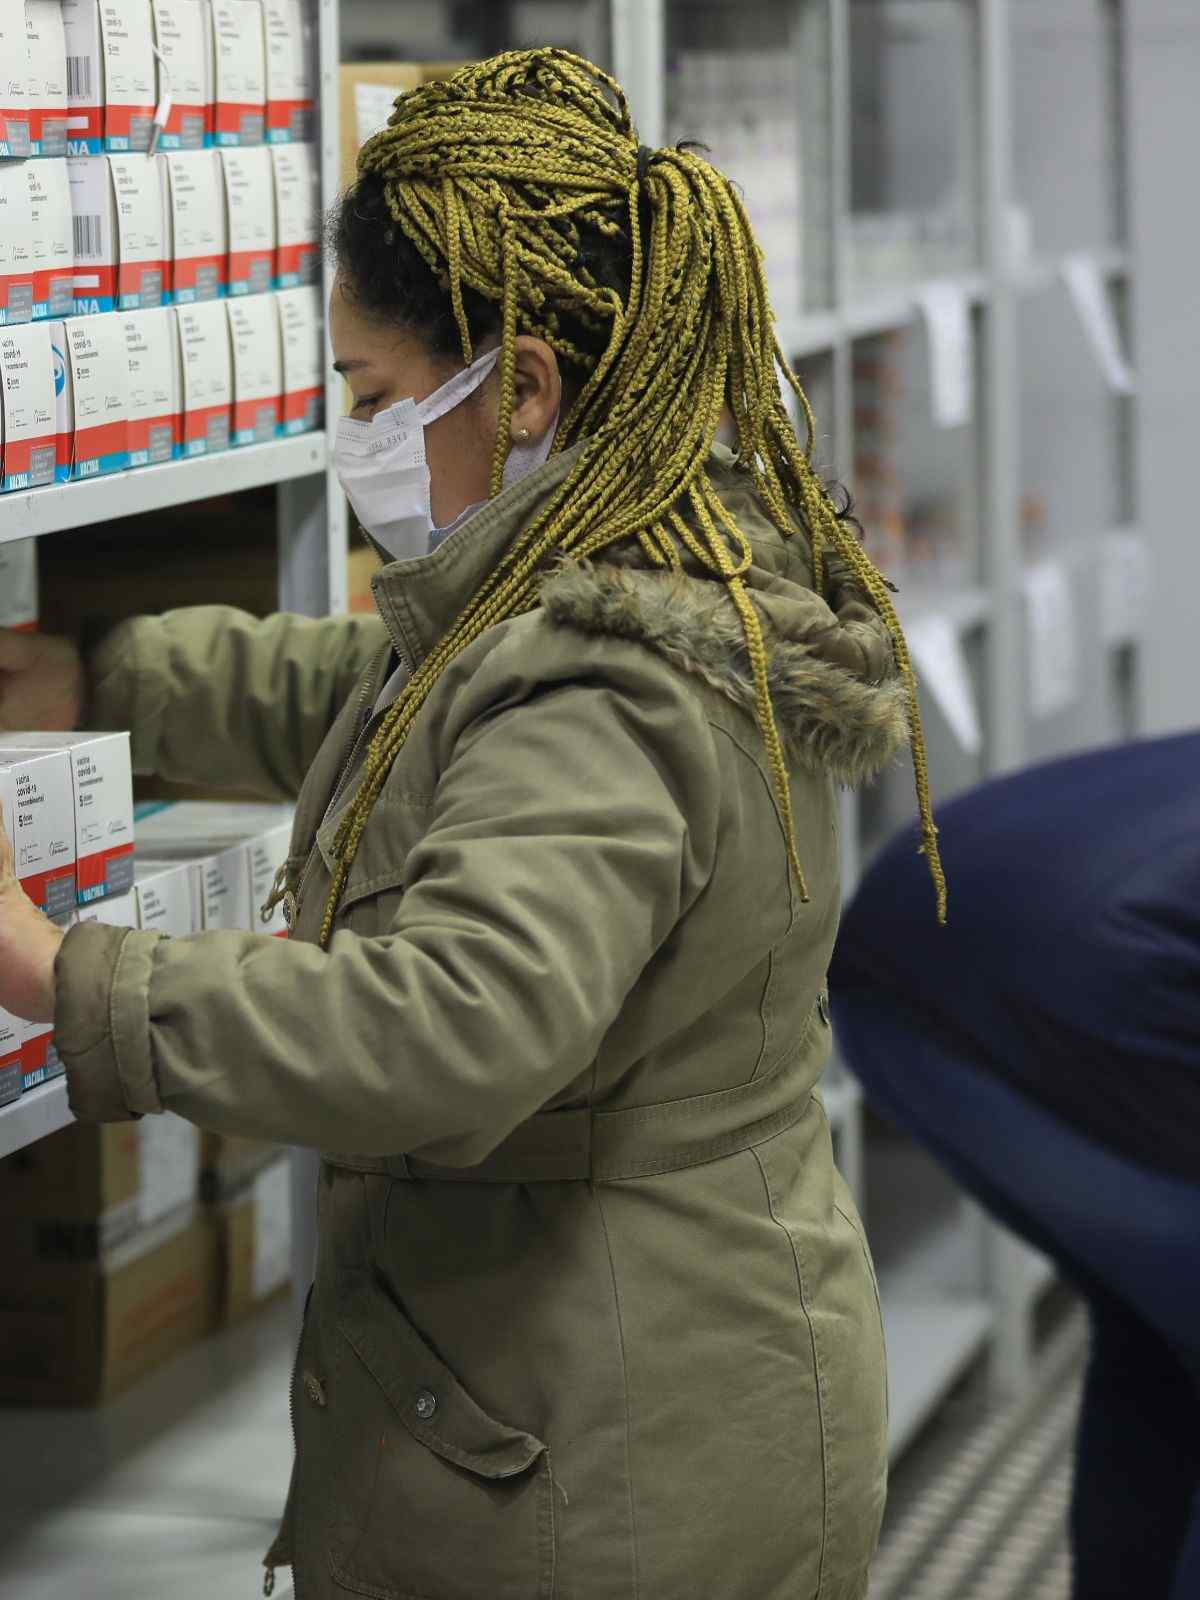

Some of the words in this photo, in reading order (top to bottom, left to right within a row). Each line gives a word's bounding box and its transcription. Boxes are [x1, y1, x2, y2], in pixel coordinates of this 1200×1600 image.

[32, 303, 48, 318] ACINA
[73, 300, 100, 313] INA
[3, 350, 21, 360] covid-19
[76, 367, 81, 380] 5
[6, 377, 11, 390] 5
[80, 460, 99, 475] VACINA
[9, 473, 28, 489] VACINA
[78, 765, 97, 777] covid-19
[16, 775, 30, 785] vacina
[16, 785, 37, 797] covid-19
[79, 795, 84, 808] 5
[18, 815, 23, 827] 5
[82, 884, 105, 901] VACINA
[24, 1069, 44, 1088] VACINA
